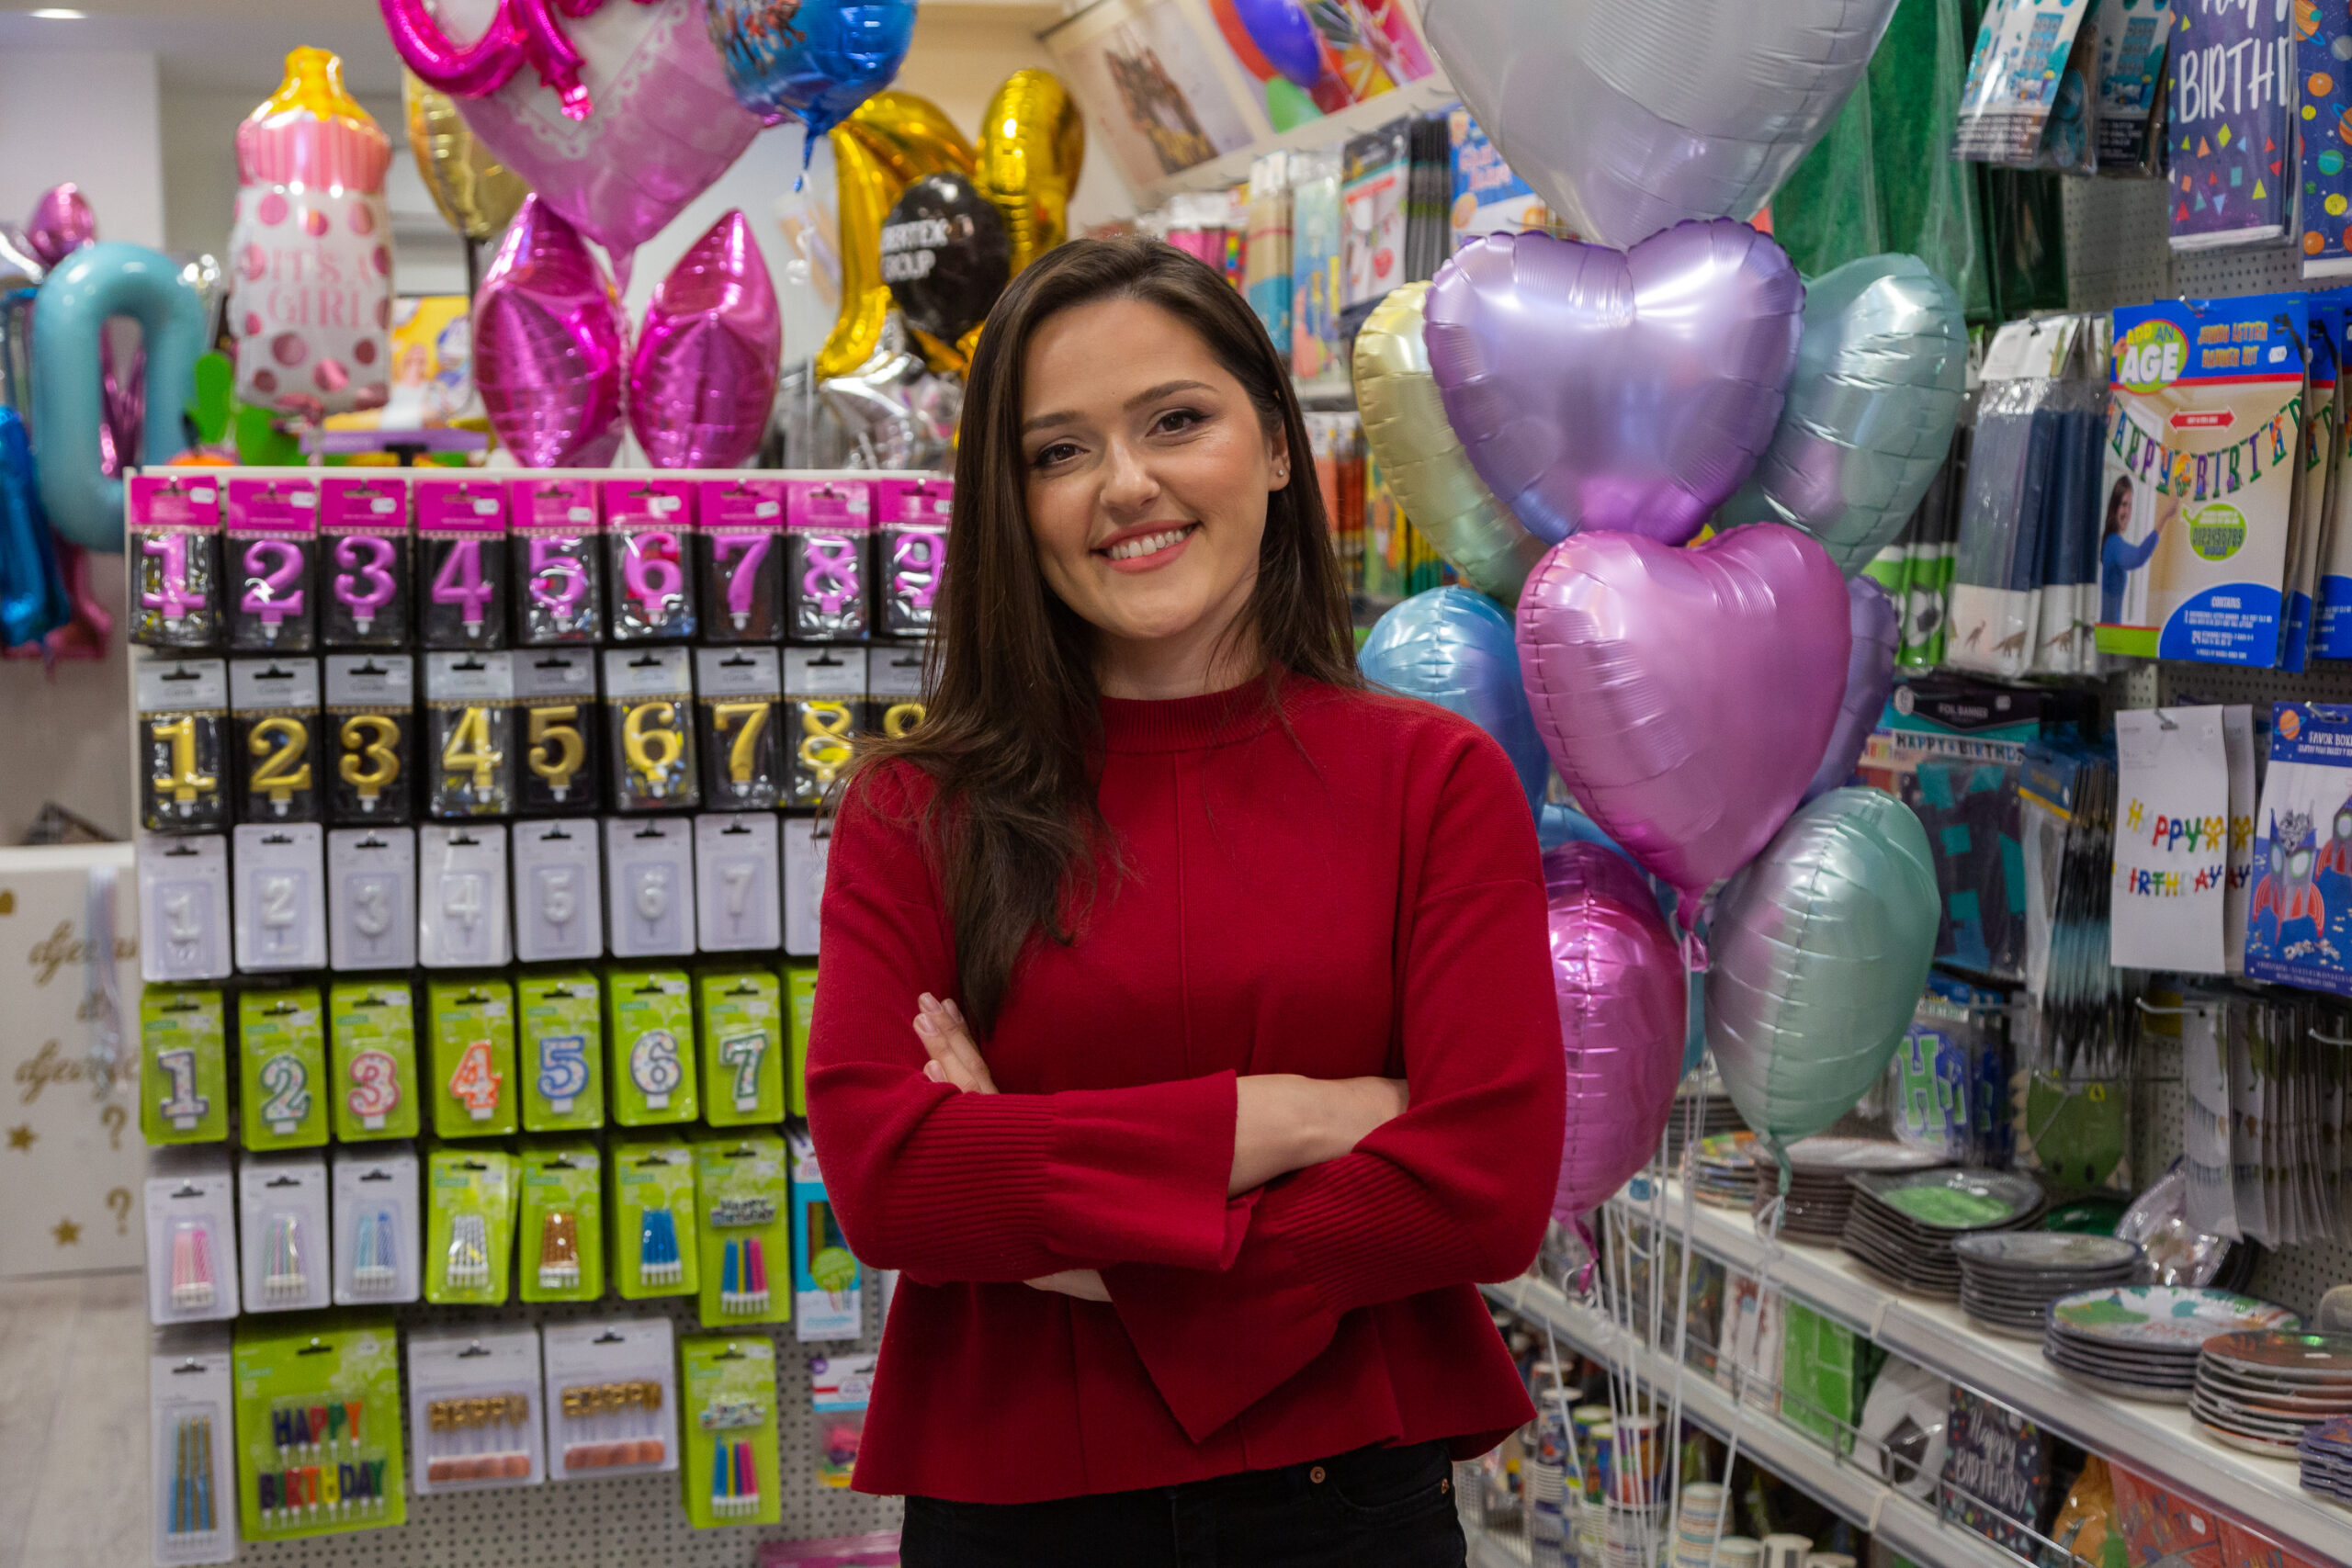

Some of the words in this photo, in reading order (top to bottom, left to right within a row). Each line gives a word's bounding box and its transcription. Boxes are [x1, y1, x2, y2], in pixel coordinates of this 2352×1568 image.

[267, 287, 368, 329] GIRL
[2126, 323, 2153, 344] ADD
[2155, 325, 2175, 343] AN
[2232, 321, 2268, 342] LETTER
[2119, 342, 2180, 385] AGE
[2242, 346, 2260, 366] KIT
[241, 540, 304, 615] 2
[334, 536, 396, 608] 3
[432, 539, 492, 623] 4
[529, 536, 586, 608] 5
[624, 533, 682, 599] 6
[713, 535, 771, 612] 7
[803, 535, 859, 601] 8
[895, 533, 947, 599] 9
[153, 716, 216, 792] 1
[248, 717, 311, 792] 2
[339, 715, 401, 788] 3
[442, 706, 502, 788] 4
[528, 705, 585, 777] 5
[623, 702, 681, 773] 6
[713, 703, 770, 781] 7
[799, 704, 853, 770] 8
[1895, 733, 1946, 752] HAPPY
[2309, 731, 2334, 745] FAVOR
[2335, 734, 2352, 746] BOX
[261, 876, 297, 927] 2
[443, 874, 480, 921] 4
[539, 869, 575, 923] 5
[724, 863, 755, 917] 7
[158, 1048, 209, 1119] 1
[260, 1053, 311, 1124] 2
[348, 1051, 401, 1117] 3
[449, 1041, 503, 1110] 4
[537, 1035, 589, 1100] 5
[629, 1030, 683, 1097] 6
[719, 1028, 769, 1100] 7
[272, 1401, 363, 1449] HAPPY
[259, 1460, 386, 1511] BIRTHDAY
